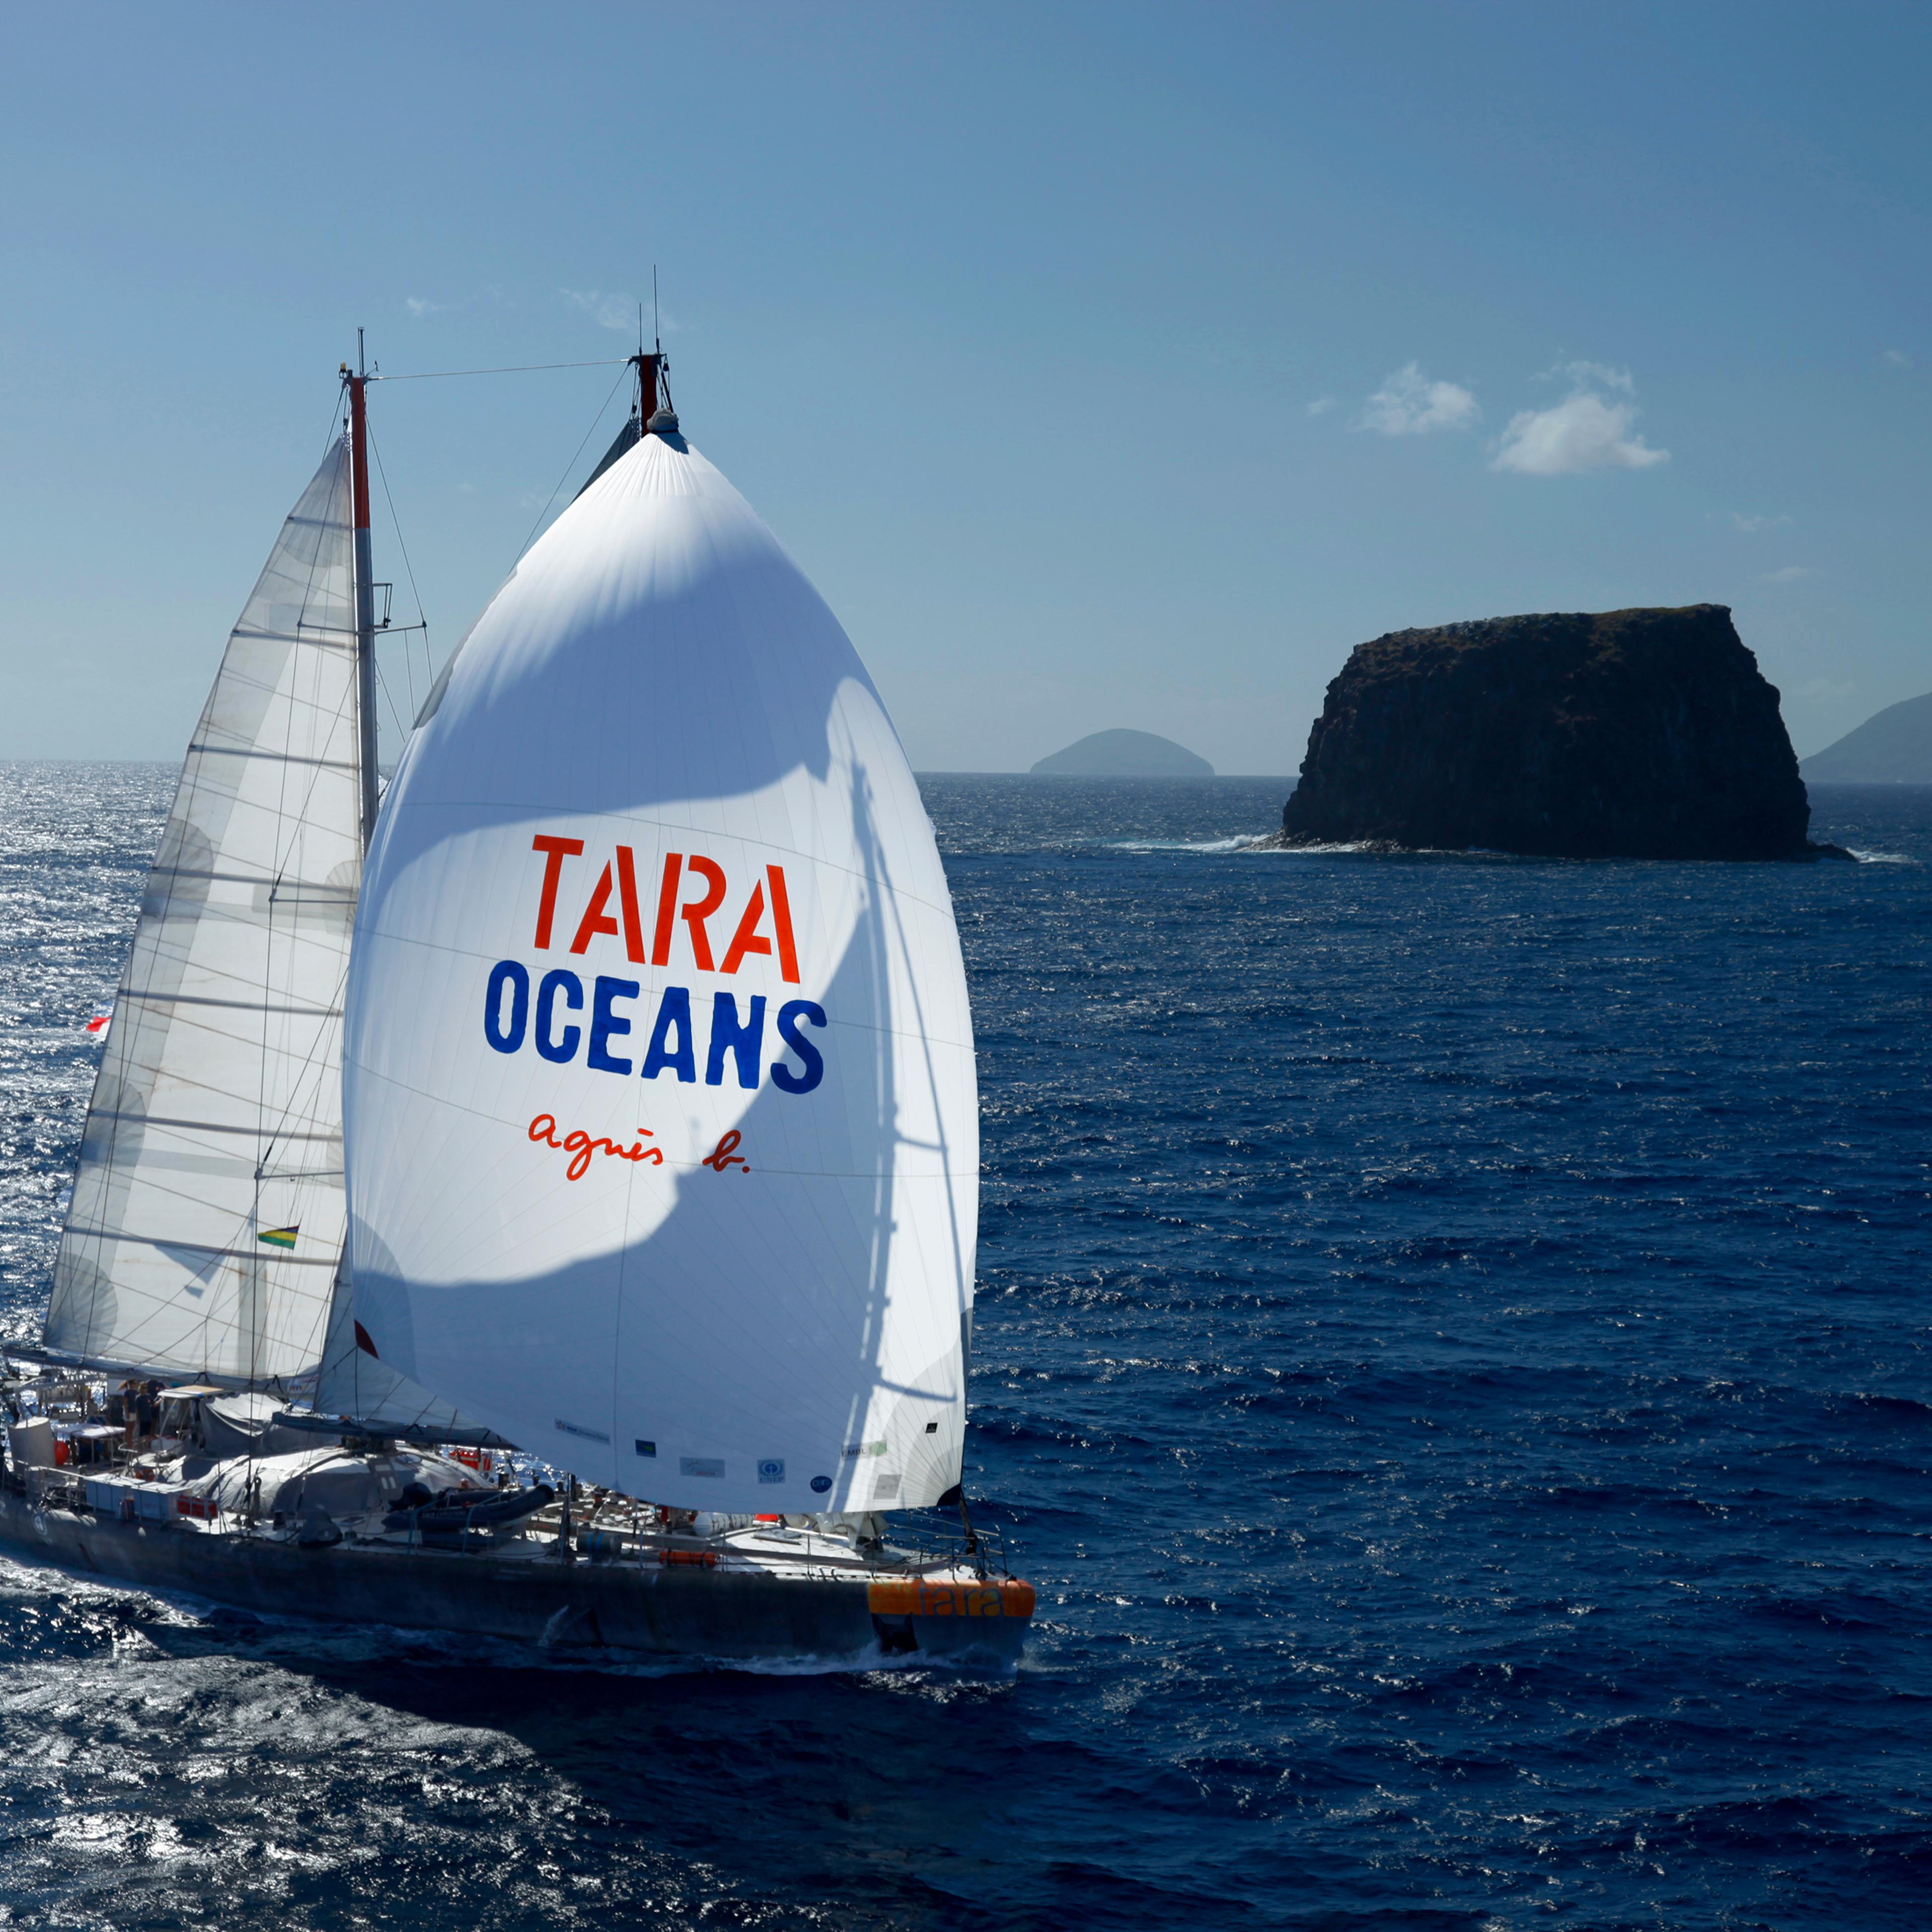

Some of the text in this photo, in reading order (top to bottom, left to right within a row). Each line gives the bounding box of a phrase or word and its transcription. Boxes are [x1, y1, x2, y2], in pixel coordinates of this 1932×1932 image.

[533, 835, 800, 984] TARA
[485, 960, 827, 1094] OCEANS
[842, 1448, 866, 1457] EMBL
[918, 1582, 1005, 1617] tara
